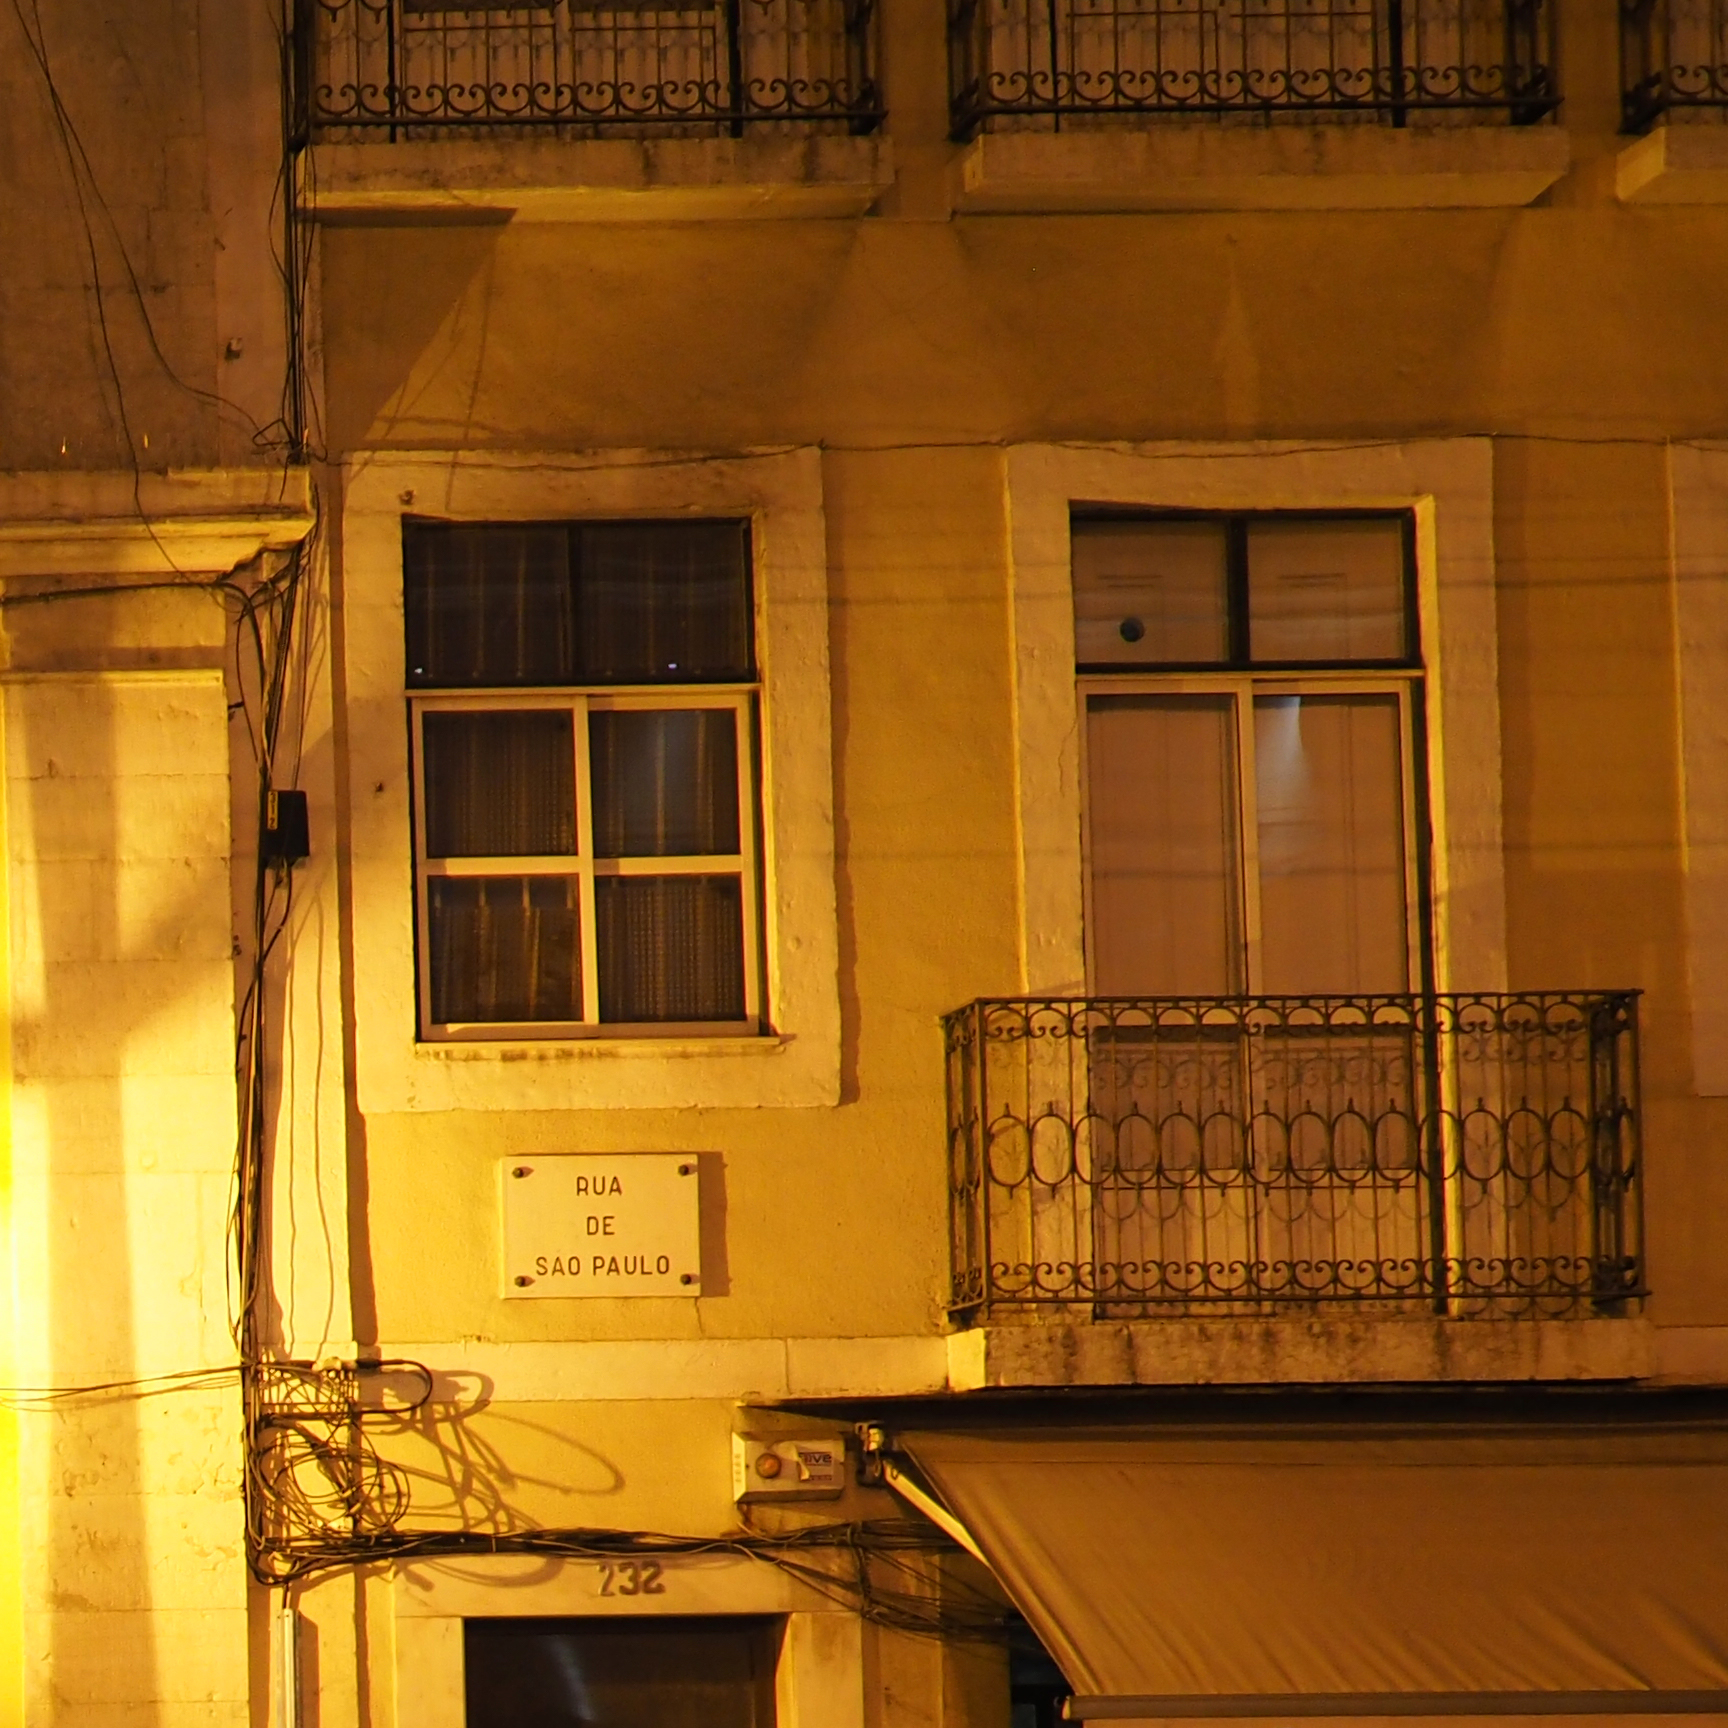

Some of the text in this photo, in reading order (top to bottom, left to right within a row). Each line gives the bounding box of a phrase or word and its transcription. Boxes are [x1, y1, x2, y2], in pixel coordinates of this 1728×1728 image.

[576, 1175, 623, 1197] RUA
[586, 1215, 616, 1236] DE
[592, 1254, 670, 1277] PAULO
[599, 1560, 666, 1597] 232
